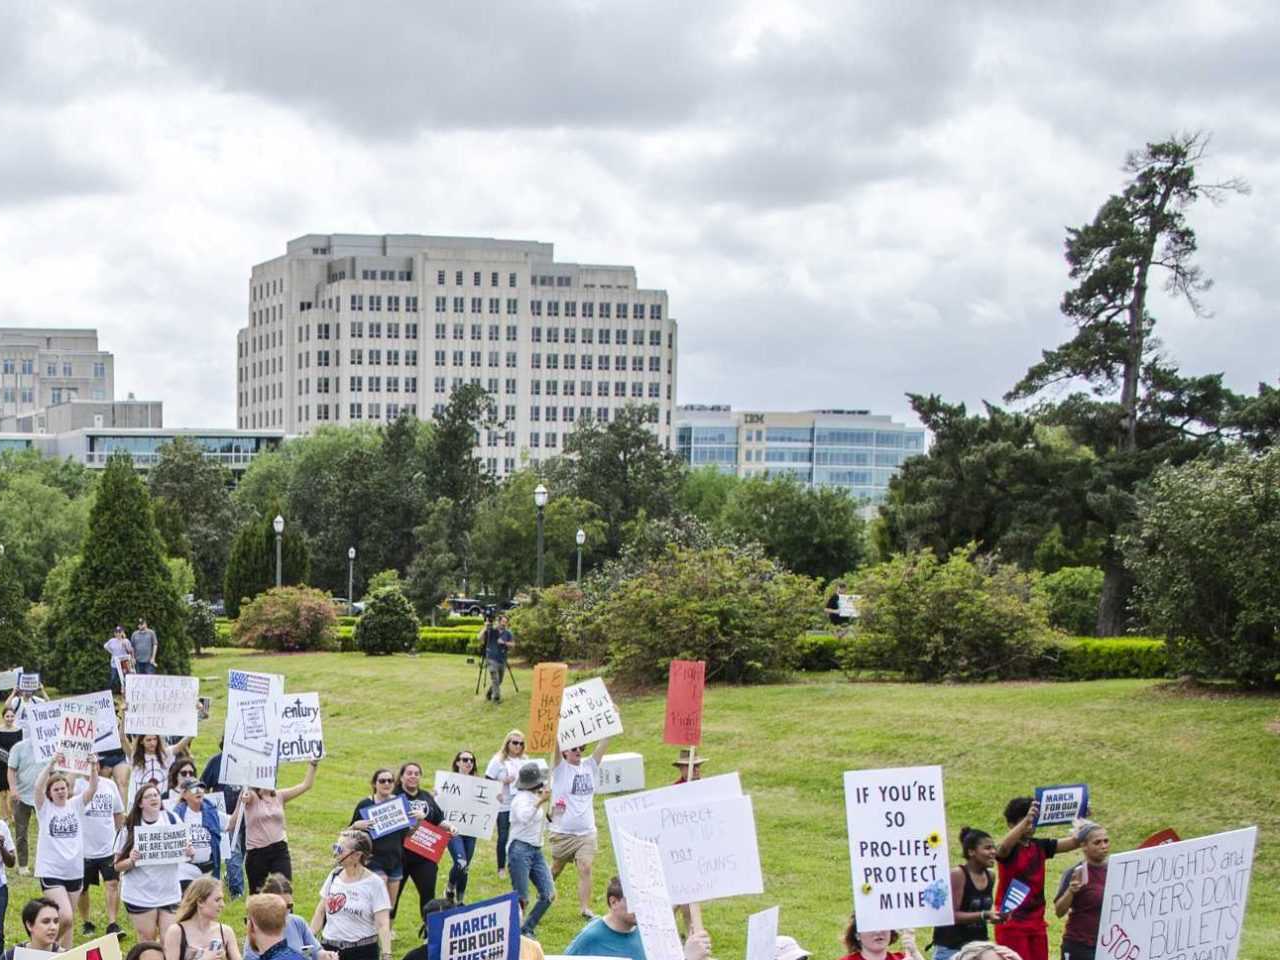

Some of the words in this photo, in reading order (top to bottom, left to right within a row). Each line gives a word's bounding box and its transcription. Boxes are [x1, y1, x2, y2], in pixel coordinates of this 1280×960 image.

[64, 717, 94, 739] NRA
[560, 728, 577, 742] MY
[441, 781, 461, 796] AM
[477, 785, 488, 799] I
[856, 786, 870, 804] IF
[878, 780, 936, 802] YOU'RE
[1045, 792, 1074, 803] MARCH
[1045, 802, 1061, 812] FOR
[660, 807, 713, 829] Protect
[885, 811, 905, 828] SO
[150, 832, 162, 840] ARE
[863, 865, 938, 884] PROTECT
[1117, 844, 1219, 891] THOUGHTS
[879, 891, 926, 910] MINE
[1108, 879, 1194, 925] PRAYERS
[449, 912, 497, 938] MARCH
[1149, 902, 1241, 960] BULLETS
[449, 938, 477, 955] FOR
[478, 928, 504, 947] OUR
